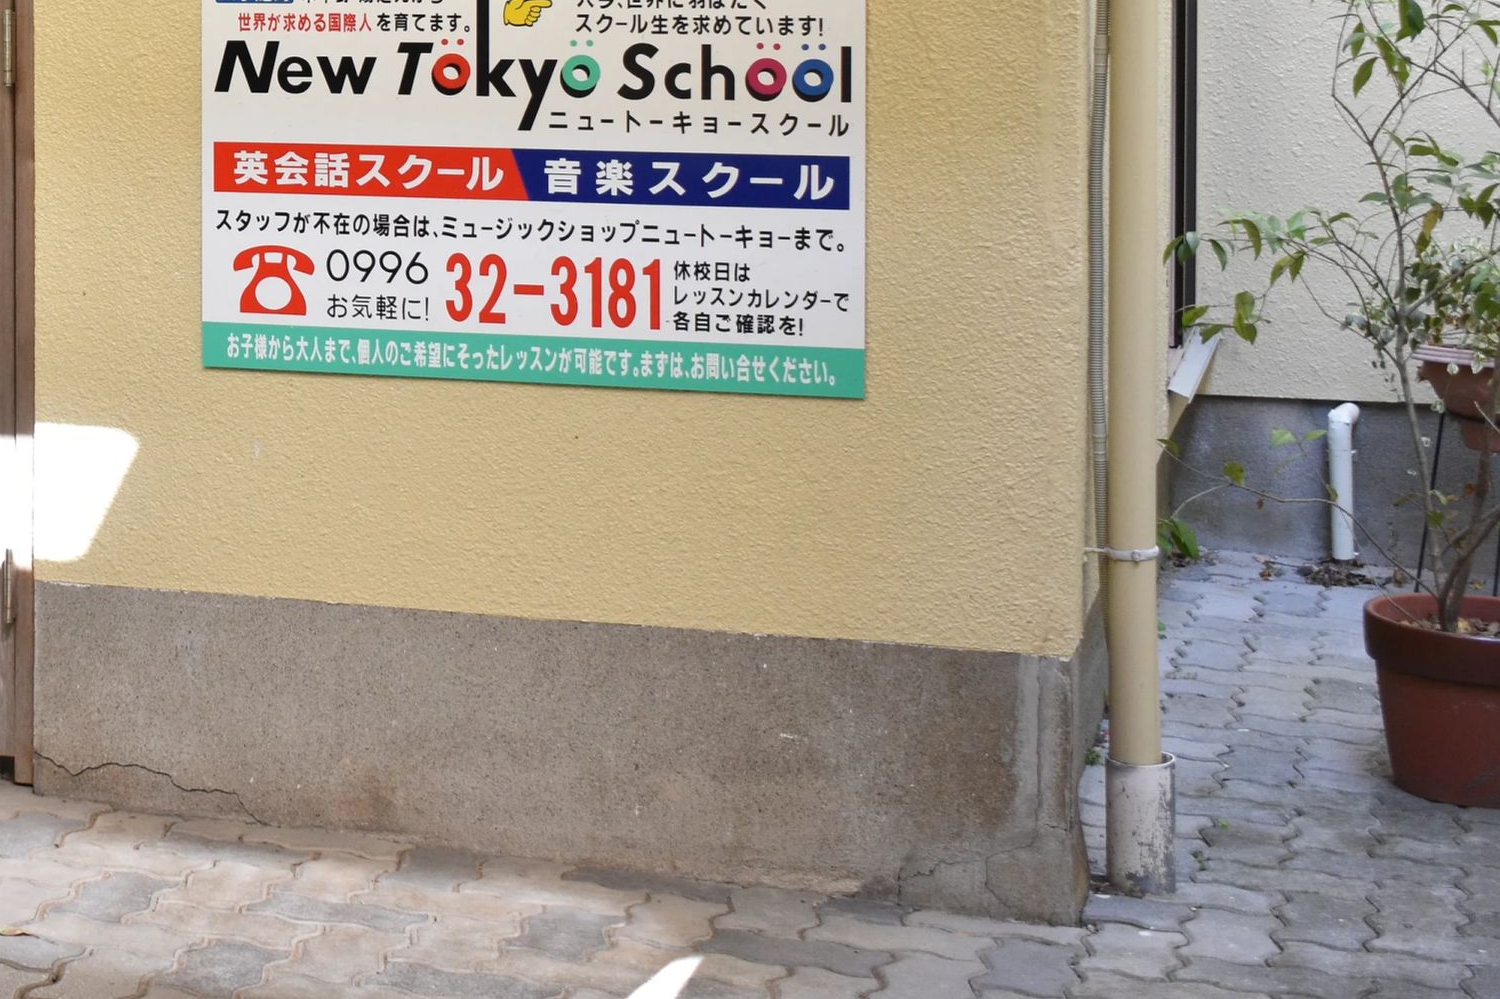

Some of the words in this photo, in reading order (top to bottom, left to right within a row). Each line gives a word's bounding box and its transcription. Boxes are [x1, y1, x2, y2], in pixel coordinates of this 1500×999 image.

[575, 13, 824, 36] スクール生を求めています!
[214, 40, 378, 95] New
[548, 109, 850, 137] ニュートーキョースクール
[233, 150, 505, 192] 英会話スクール
[543, 157, 835, 201] 音楽スクール
[673, 260, 751, 283] 休校日は
[326, 249, 429, 285] 0996
[445, 252, 661, 331] 32-3181
[673, 285, 850, 313] レッスンカレンダーで
[327, 294, 430, 322] お気軽に!
[672, 311, 804, 337] 各自ご確認を!
